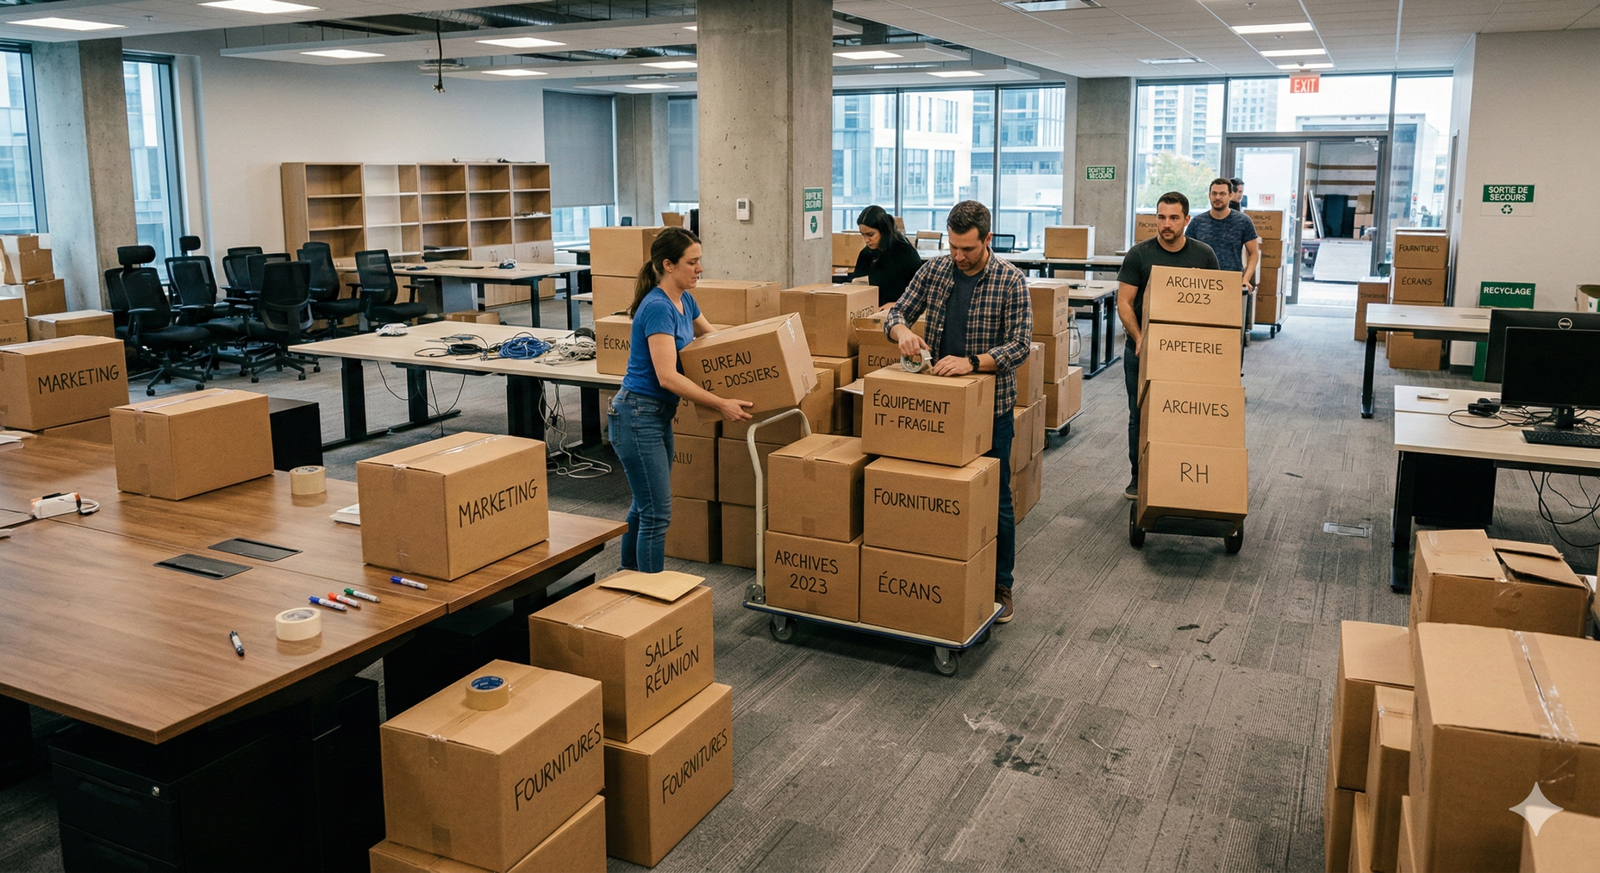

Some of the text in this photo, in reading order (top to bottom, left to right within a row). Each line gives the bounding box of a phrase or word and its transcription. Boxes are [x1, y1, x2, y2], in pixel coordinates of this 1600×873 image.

[1294, 78, 1316, 93] EXIT
[1488, 186, 1528, 194] SORTIE DE
[1166, 276, 1224, 291] ARCHIVES
[1401, 276, 1433, 286] ÉCRANS
[1483, 286, 1532, 296] RECYCLAGE
[1177, 292, 1211, 305] 2023
[603, 334, 632, 351] ÉCRAN
[1159, 339, 1223, 355] PAPETERIE
[701, 351, 752, 374] BUREAU
[38, 364, 119, 395] MARKETING
[725, 366, 780, 389] DOSSIERS
[873, 389, 951, 415] ÉQUIPEMENT
[1162, 399, 1229, 418] ARCHIVES
[875, 413, 887, 426] IT
[898, 415, 945, 433] FRAGILE
[1180, 461, 1209, 484] RH
[458, 478, 538, 528] MARKETING
[873, 488, 961, 516] FOURNITURES
[774, 549, 839, 575] ARCHIVES
[789, 573, 828, 595] 2023
[878, 570, 943, 604] ÉCRANS
[644, 627, 684, 668] SALLE
[645, 645, 700, 699] RÉUNION
[513, 722, 602, 812] FOURNITURES
[661, 728, 728, 804] FOURNITURES
